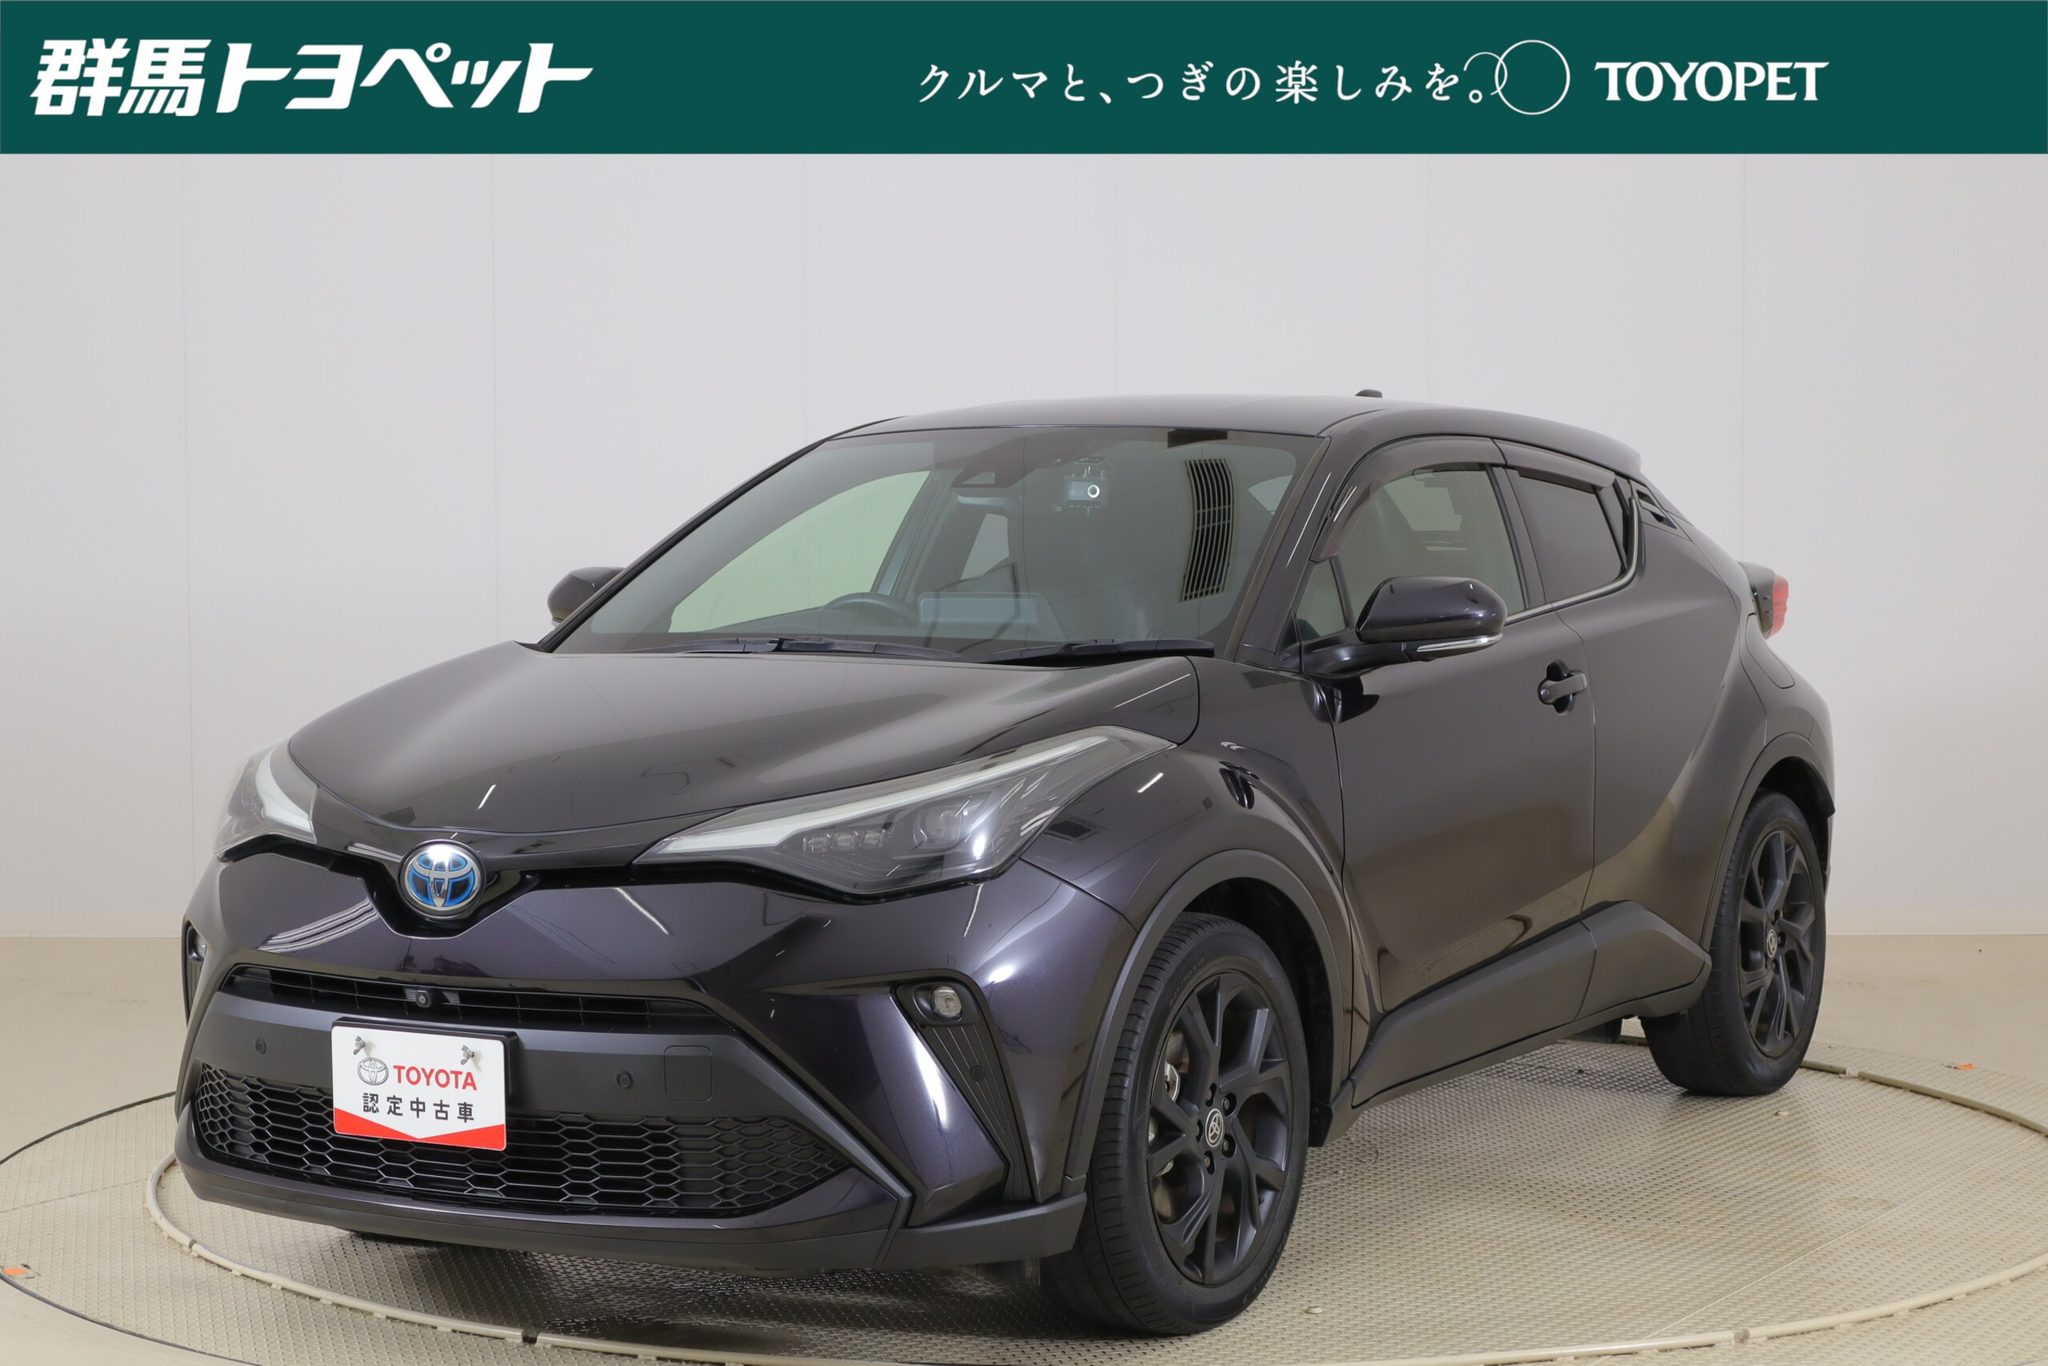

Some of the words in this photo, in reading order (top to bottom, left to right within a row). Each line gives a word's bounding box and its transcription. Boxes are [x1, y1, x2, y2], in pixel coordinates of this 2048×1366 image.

[392, 1064, 478, 1091] TOYOTA
[362, 1092, 475, 1123] 認定中古車
